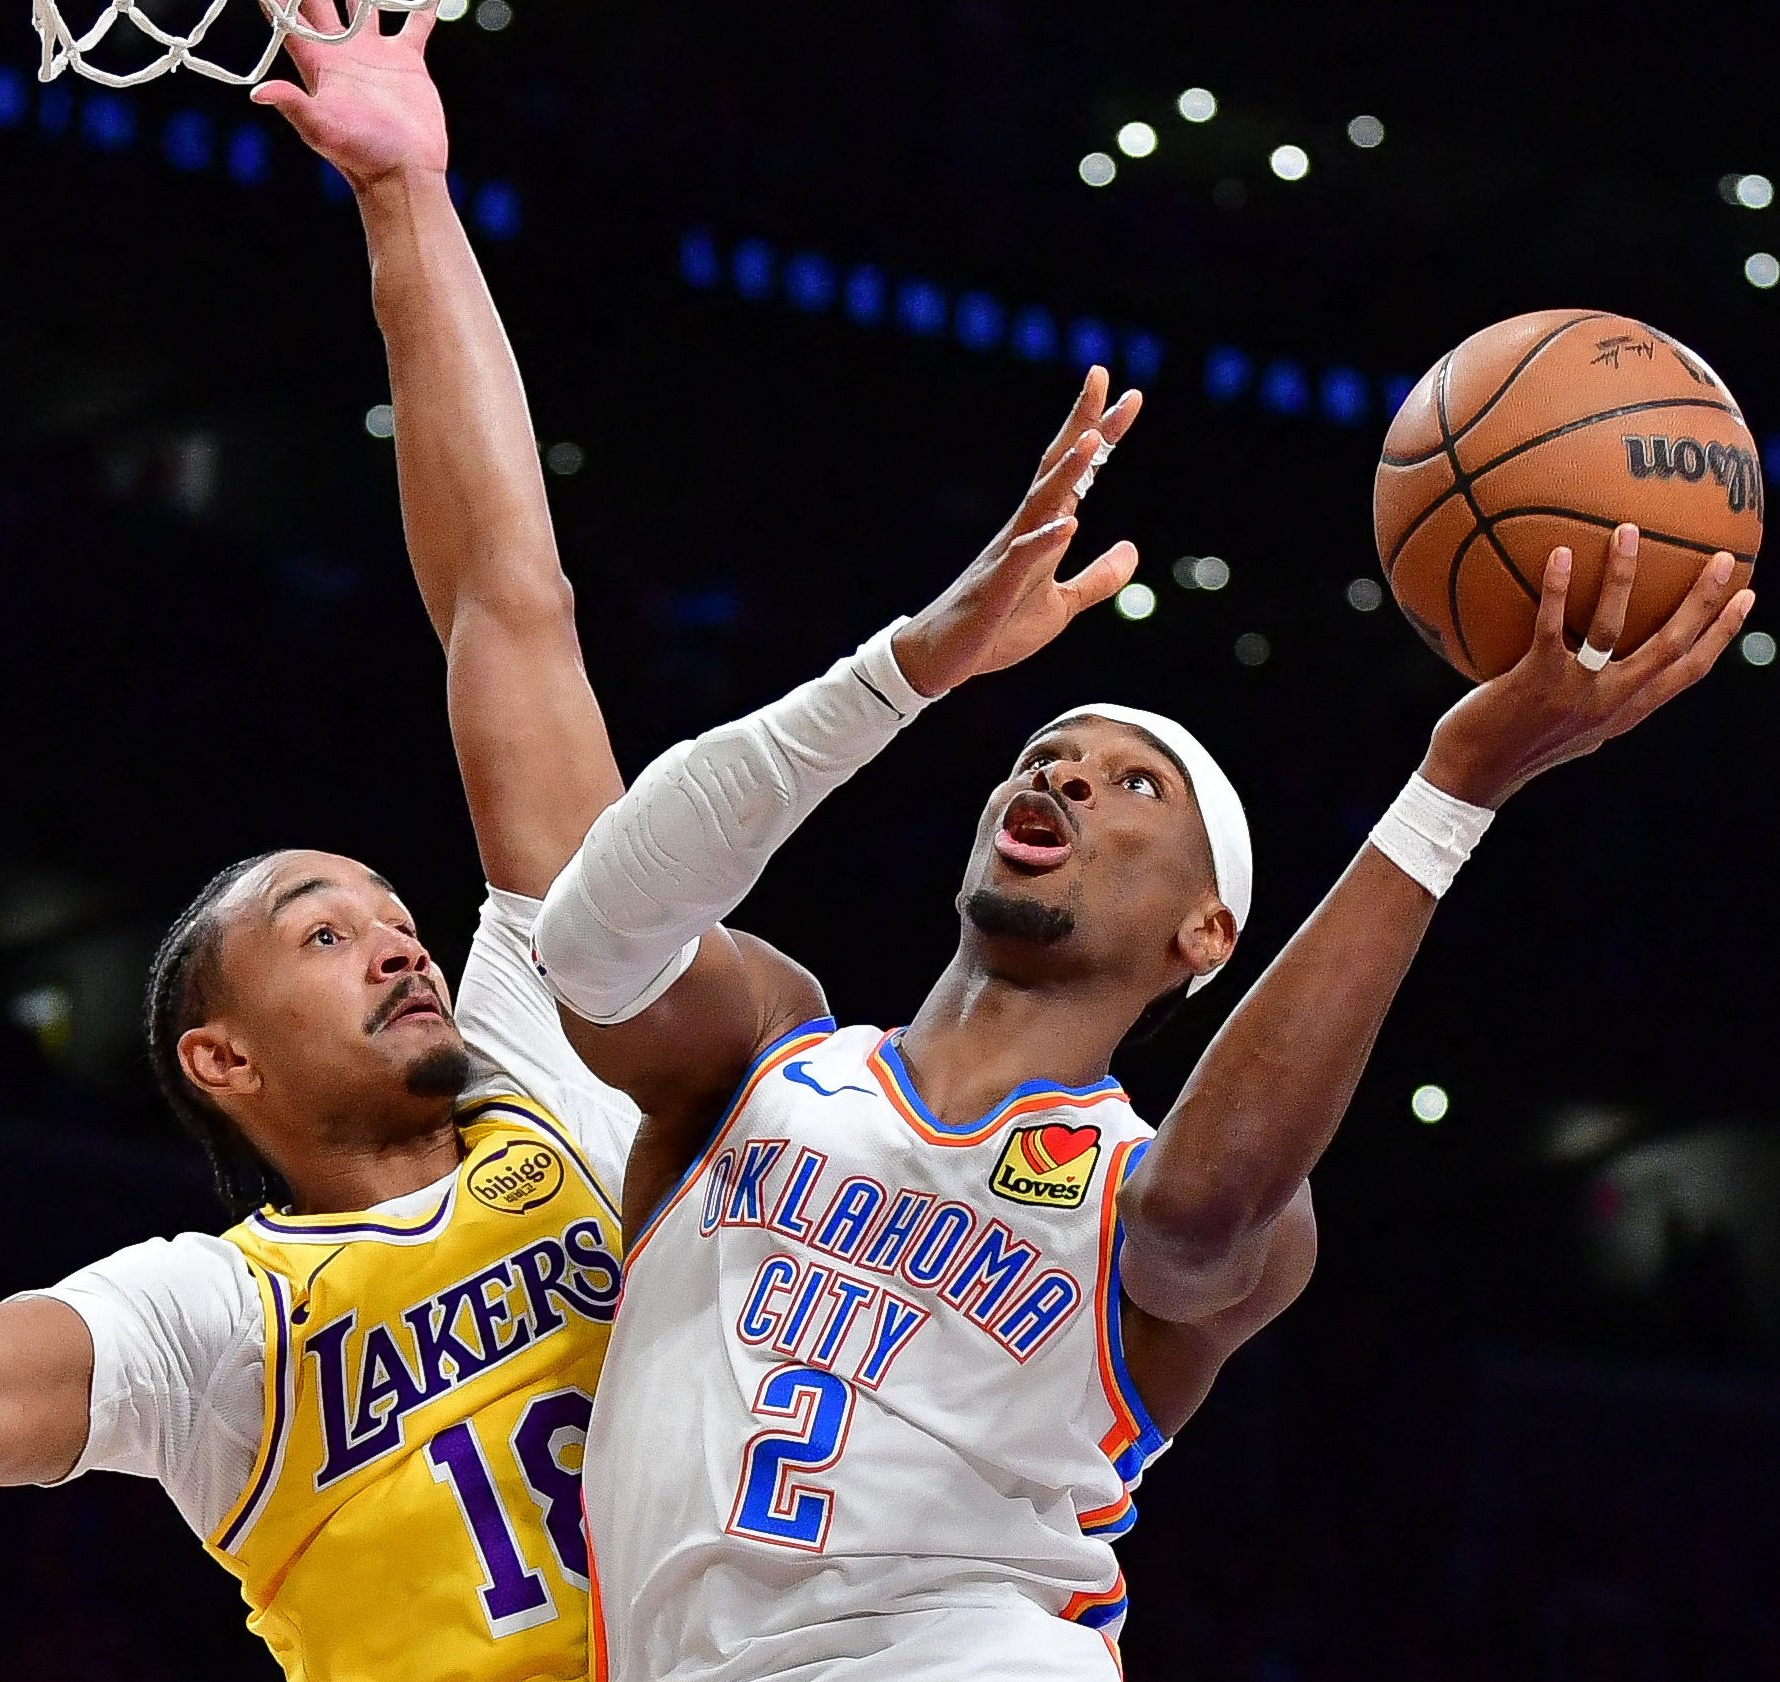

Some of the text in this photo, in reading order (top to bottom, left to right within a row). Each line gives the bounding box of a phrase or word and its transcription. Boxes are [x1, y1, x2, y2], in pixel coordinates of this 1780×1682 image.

[474, 1152, 552, 1201] bibigo
[699, 1137, 1082, 1365] OKLAHOMA
[301, 1219, 622, 1492] LAKERS
[736, 1252, 931, 1394] CITY
[725, 1363, 858, 1553] 2
